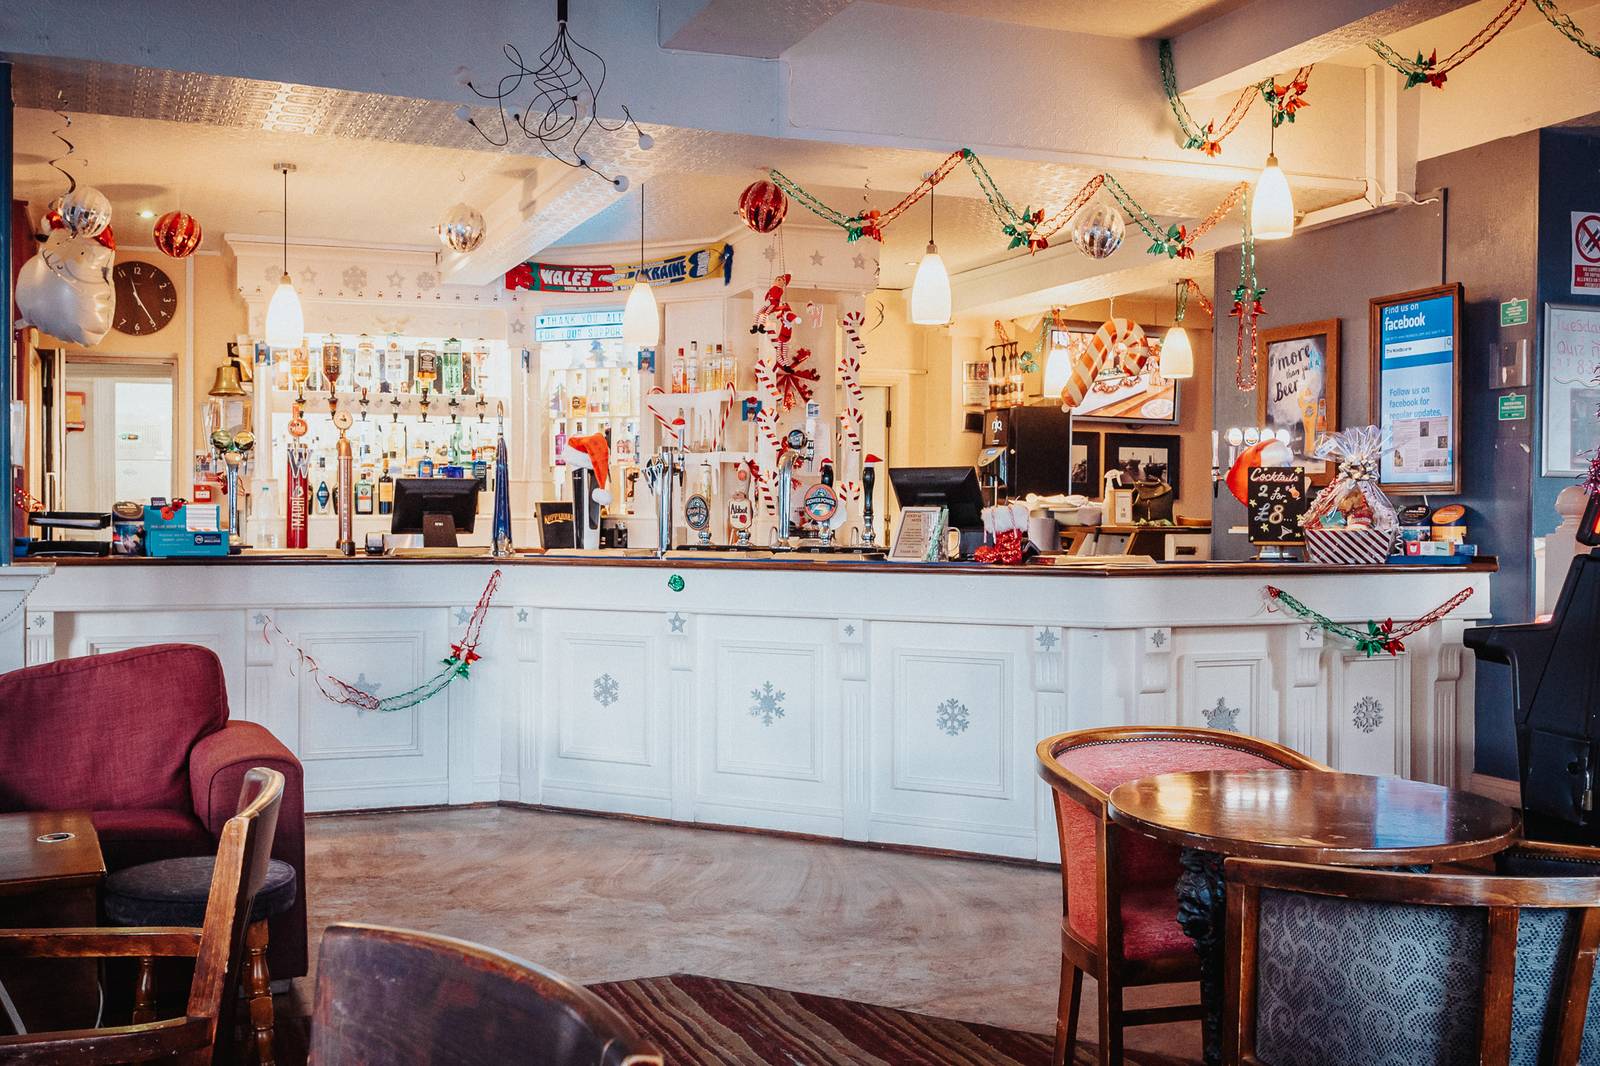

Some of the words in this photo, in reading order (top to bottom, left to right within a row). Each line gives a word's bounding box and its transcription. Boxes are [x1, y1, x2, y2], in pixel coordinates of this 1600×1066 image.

[134, 267, 141, 275] 12
[540, 268, 593, 286] WALES
[1385, 306, 1398, 314] Find
[547, 314, 576, 325] THANK
[1385, 312, 1426, 331] facebook
[588, 327, 621, 337] SUPPOR
[1278, 344, 1310, 370] more
[1274, 380, 1298, 402] Beer
[1390, 388, 1409, 396] Follow
[1389, 398, 1418, 408] facebook
[1420, 397, 1430, 405] for
[1390, 410, 1412, 419] regular
[1250, 468, 1298, 482] Cocktails
[1258, 484, 1268, 497] 2
[1270, 487, 1286, 500] for
[731, 504, 748, 514] Abbot
